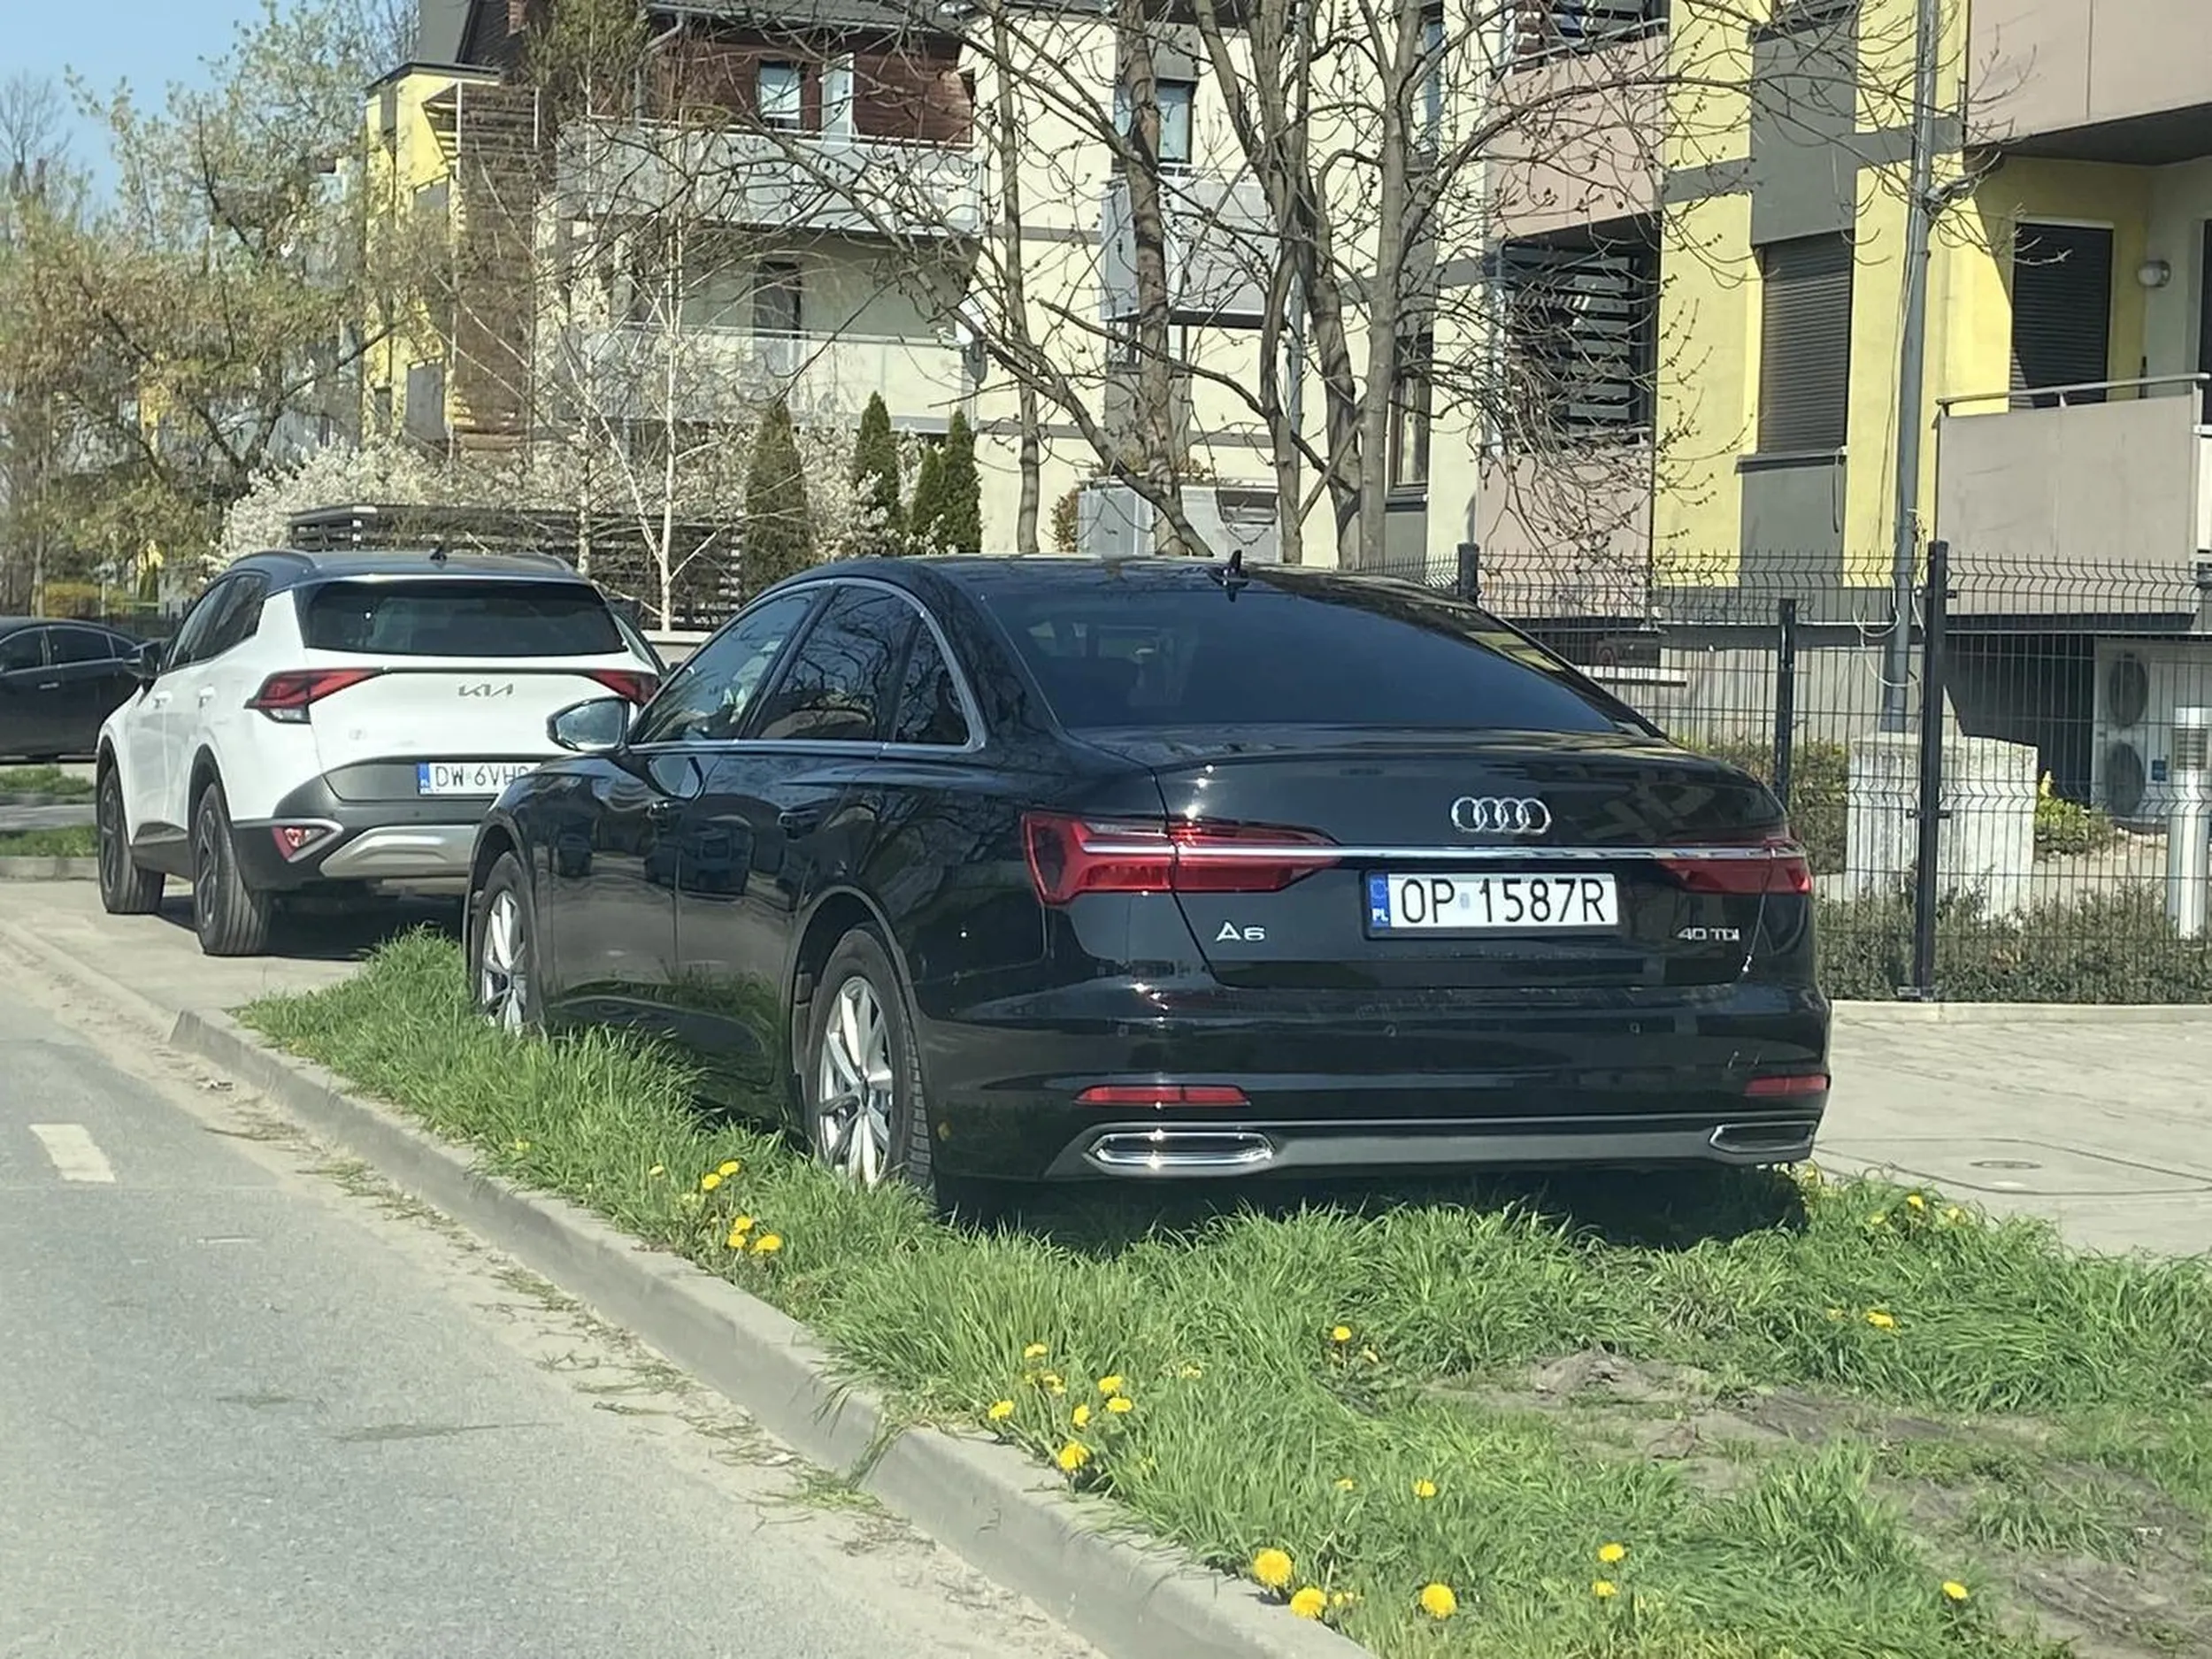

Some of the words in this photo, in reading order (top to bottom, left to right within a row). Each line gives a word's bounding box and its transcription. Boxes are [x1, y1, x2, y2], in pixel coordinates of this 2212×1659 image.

[458, 684, 513, 697] KIA
[435, 765, 464, 787] DW
[1401, 878, 1455, 923] OP
[1479, 878, 1605, 922] 1587R
[1371, 908, 1389, 922] PL
[1216, 921, 1265, 941] A6
[1678, 927, 1708, 941] 40
[1709, 927, 1740, 941] TDI
